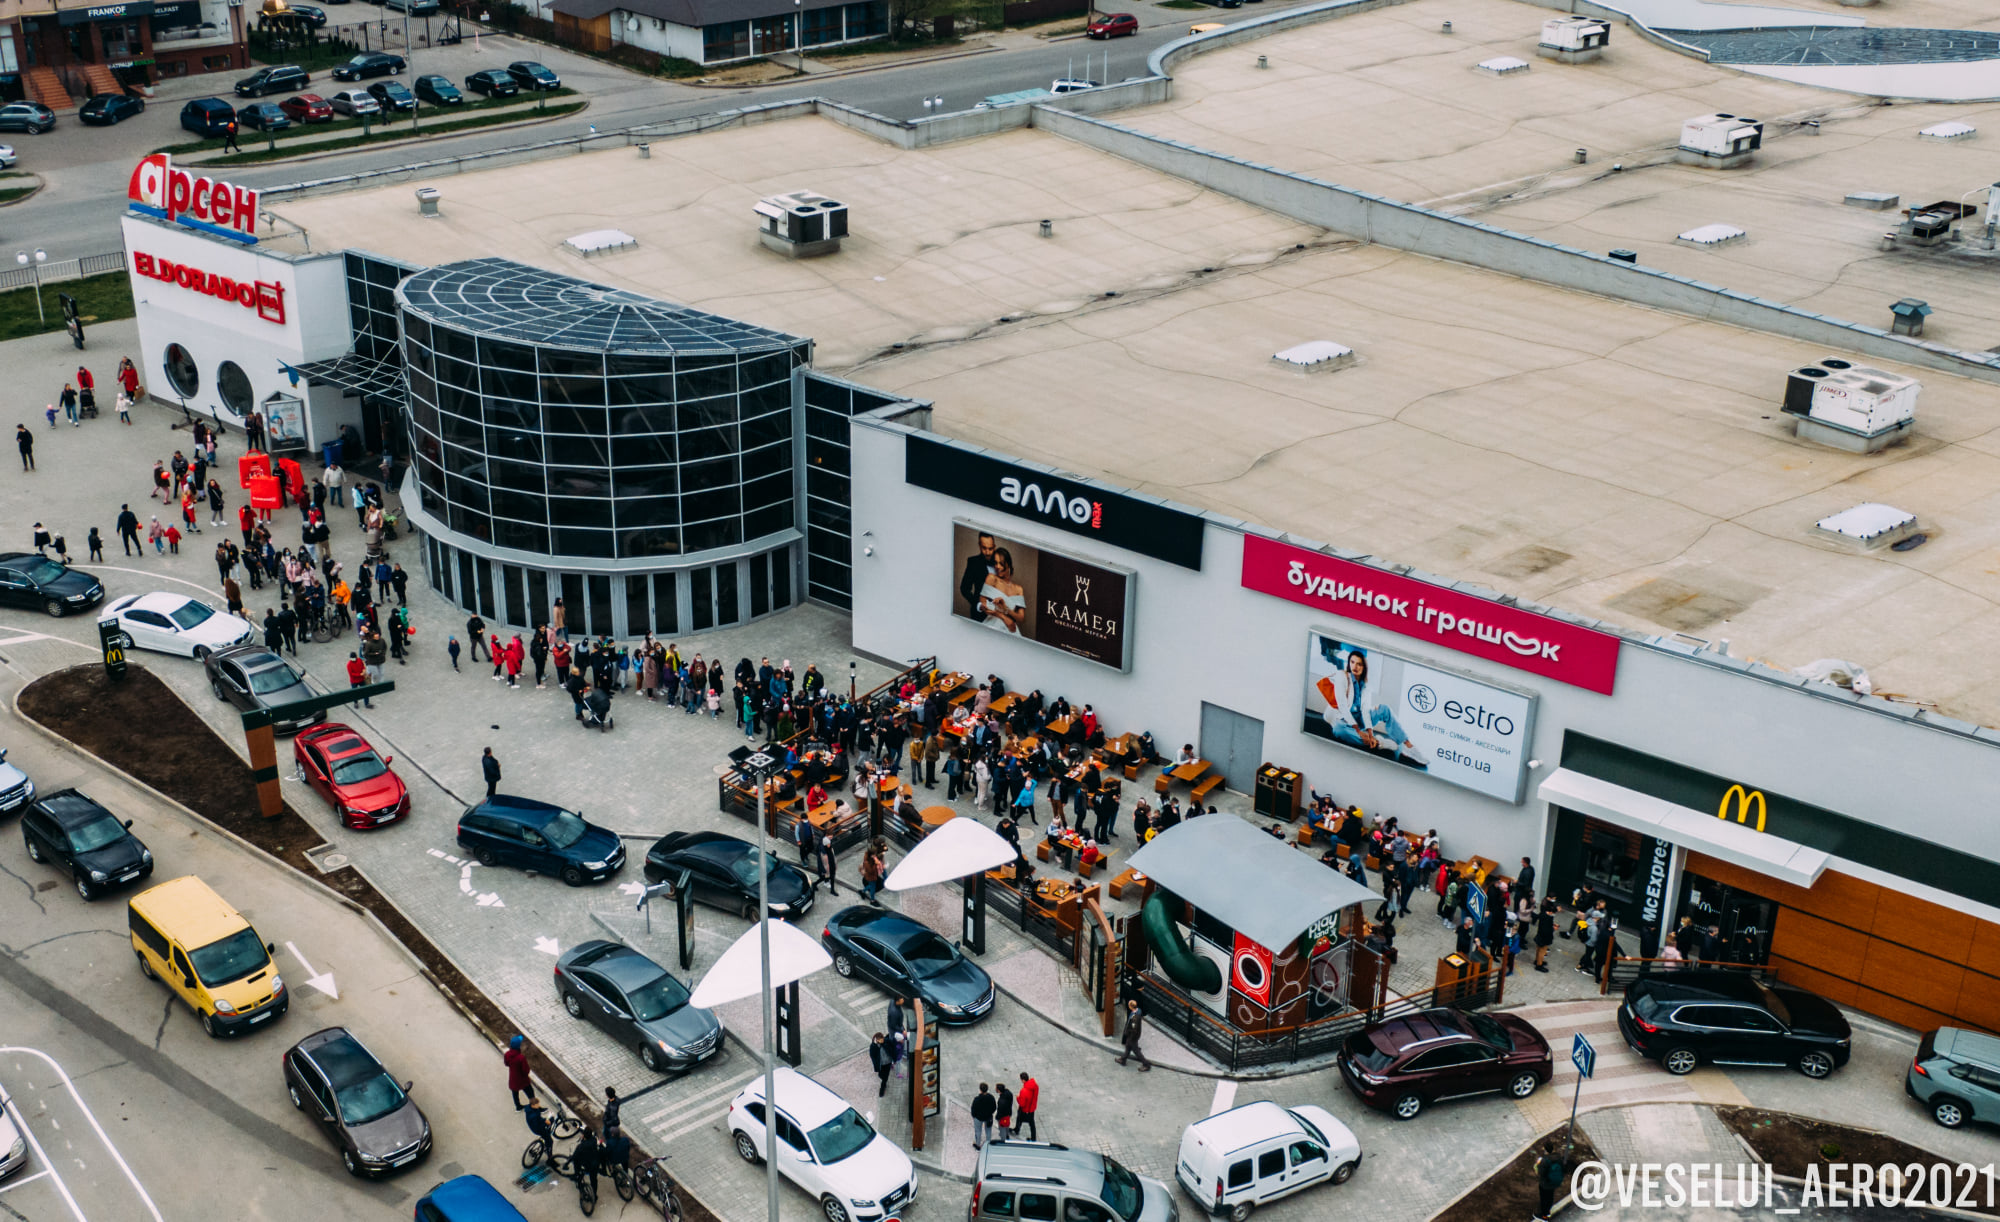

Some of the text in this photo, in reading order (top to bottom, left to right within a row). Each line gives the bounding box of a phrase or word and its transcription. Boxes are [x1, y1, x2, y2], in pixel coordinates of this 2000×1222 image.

[88, 5, 126, 17] FRANKOF
[133, 251, 256, 308] ELDORADO
[1047, 600, 1116, 635] КАМЕЯ
[1287, 560, 1561, 662] будинок іграшок
[1444, 700, 1514, 735] estro
[1437, 747, 1491, 773] estro.ua
[1642, 838, 1669, 922] McExpres
